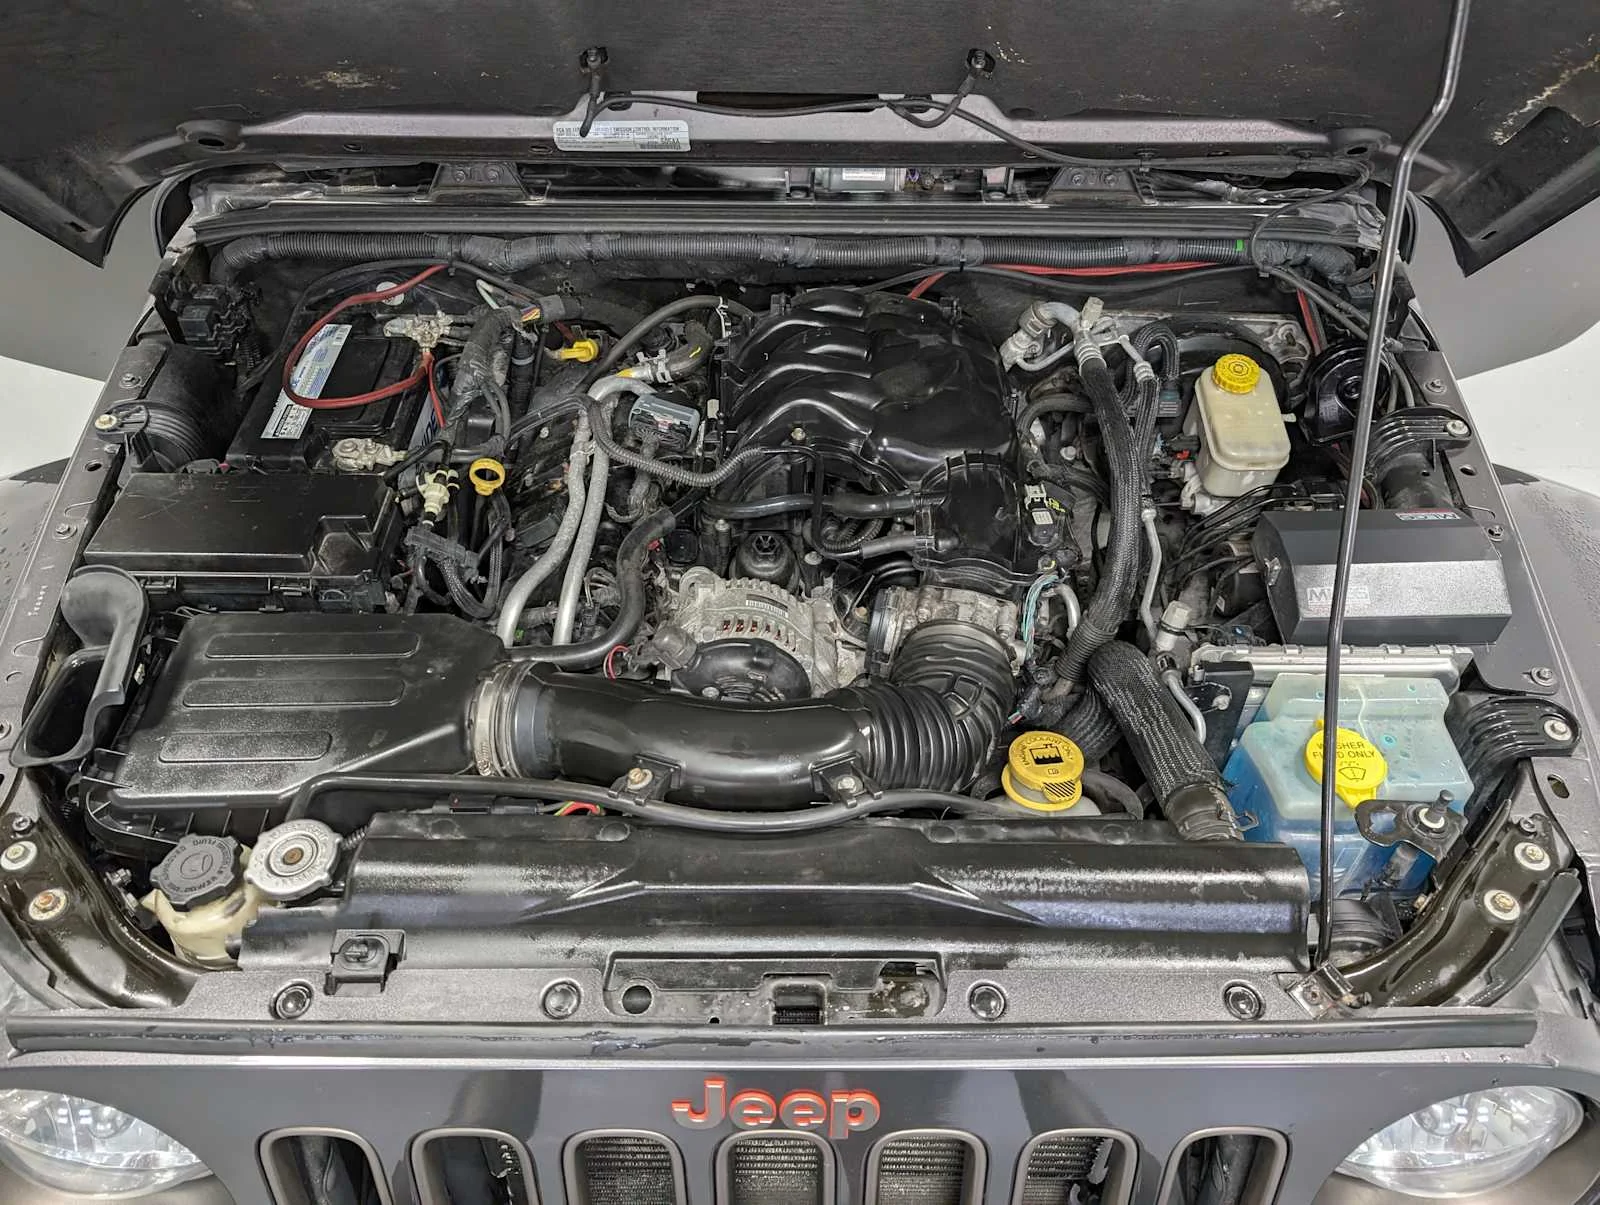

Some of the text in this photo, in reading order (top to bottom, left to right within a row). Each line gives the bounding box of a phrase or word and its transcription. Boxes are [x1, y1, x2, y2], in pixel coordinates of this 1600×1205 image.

[1316, 741, 1365, 750] WSHER
[1347, 750, 1375, 758] ONLY
[671, 1077, 881, 1140] Jeep
